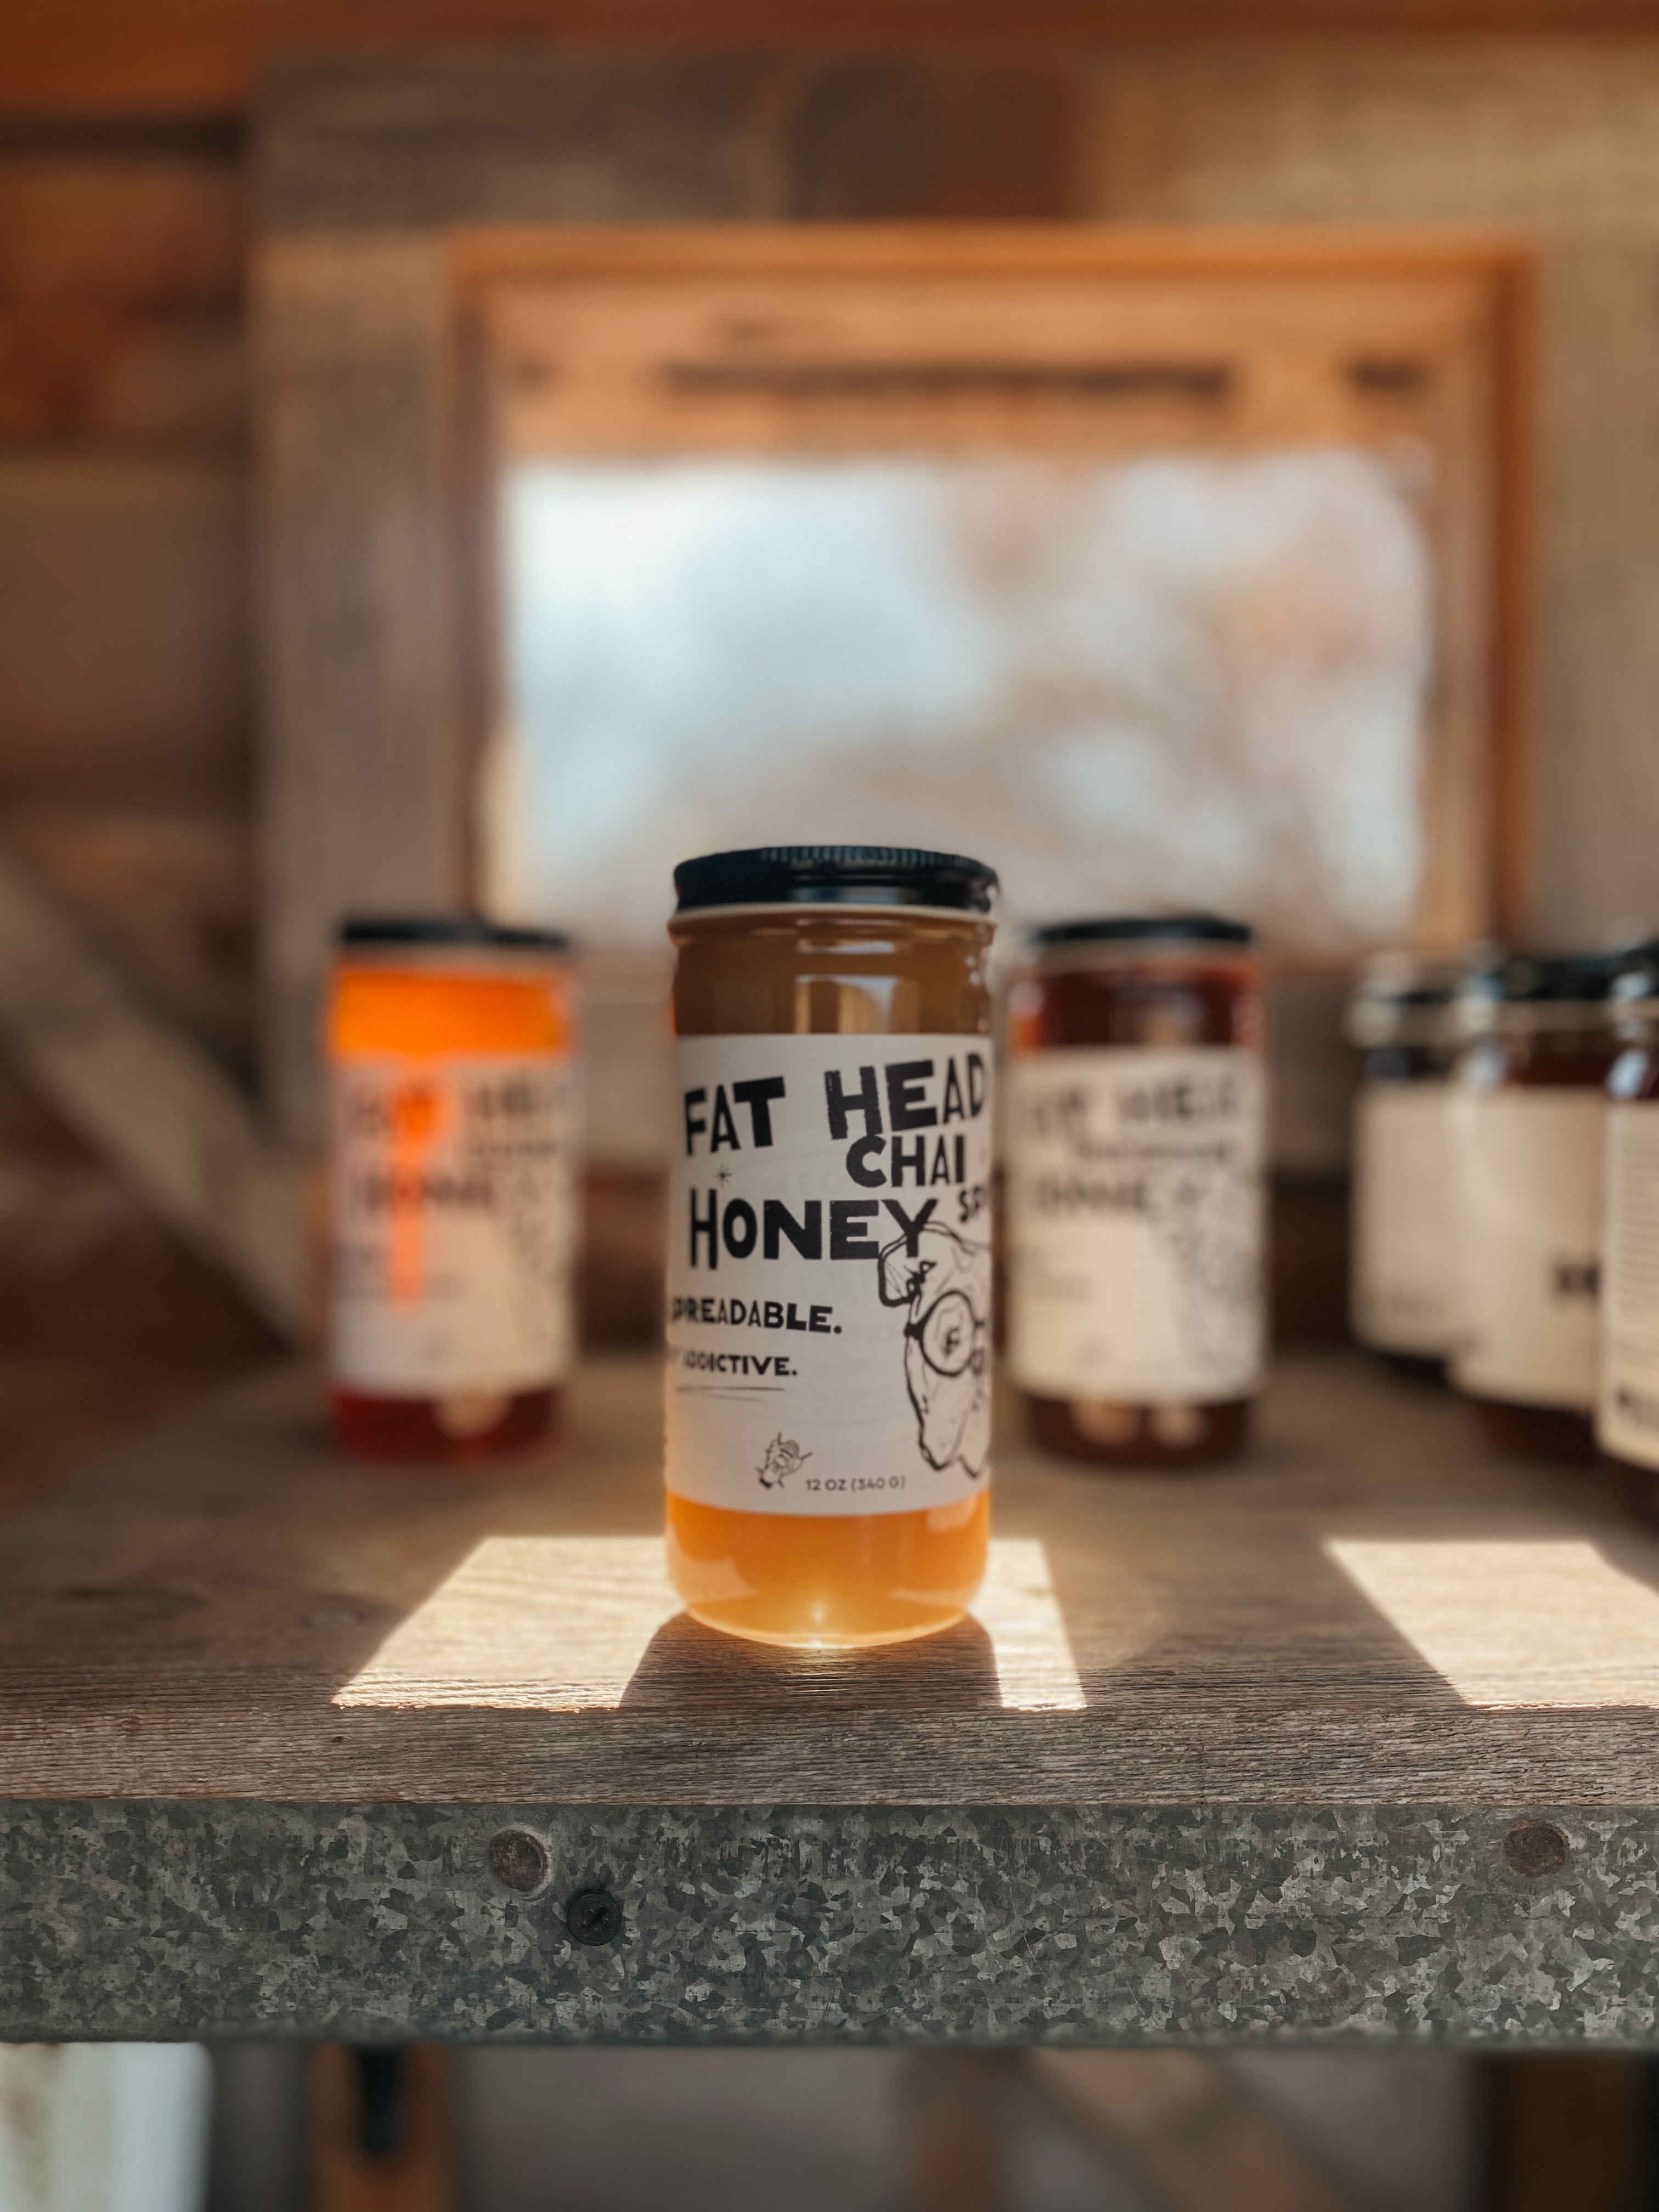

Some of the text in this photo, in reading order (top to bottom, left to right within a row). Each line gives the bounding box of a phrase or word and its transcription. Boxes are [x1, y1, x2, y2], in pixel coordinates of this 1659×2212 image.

[684, 1076, 786, 1155] FAT
[824, 1052, 985, 1140] HEAD
[845, 1133, 964, 1188] CHAI
[690, 1188, 938, 1270] HONEY
[806, 1478, 821, 1492] 12
[825, 1478, 847, 1492] OZ
[851, 1476, 885, 1493] (340
